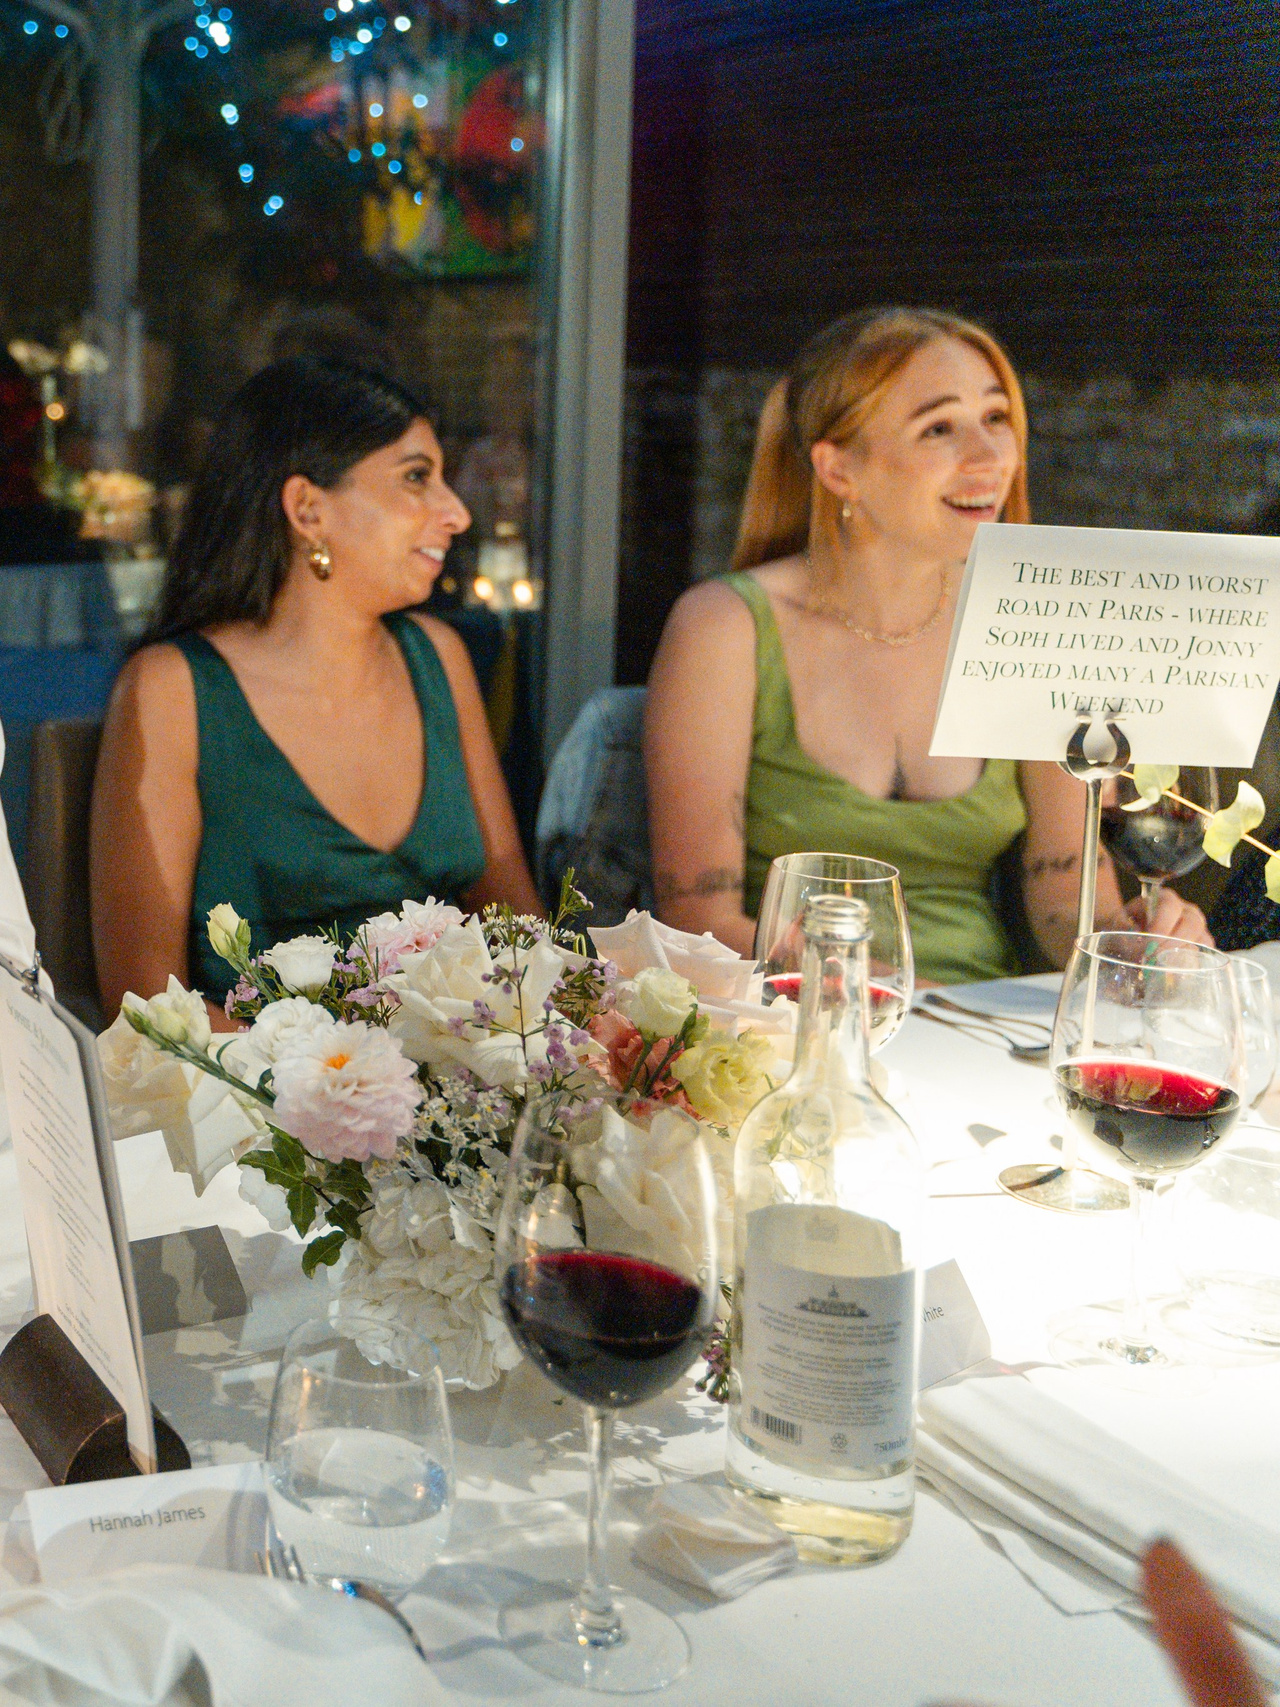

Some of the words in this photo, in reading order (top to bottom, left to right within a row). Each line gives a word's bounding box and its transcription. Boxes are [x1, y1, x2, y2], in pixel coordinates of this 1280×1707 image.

[1013, 562, 1062, 586] THE
[1070, 569, 1125, 588] BEST
[1131, 573, 1180, 591] AND
[1188, 574, 1269, 596] WORST
[996, 598, 1059, 618] ROAD
[1066, 601, 1092, 618] IN
[1098, 599, 1164, 622] PARIS
[1188, 607, 1269, 628] WHERE
[985, 626, 1048, 648] SOPH
[1057, 632, 1123, 651] LIVED
[1129, 637, 1178, 655] AND
[1178, 636, 1263, 660] JONNY
[961, 660, 1061, 682] ENJOYED
[1067, 664, 1136, 684] MANY
[1140, 668, 1154, 684] A
[1163, 665, 1270, 690] PARISIAN
[1049, 690, 1164, 715] WEEKEND
[90, 1509, 152, 1532] Hannah
[158, 1505, 205, 1526] James
